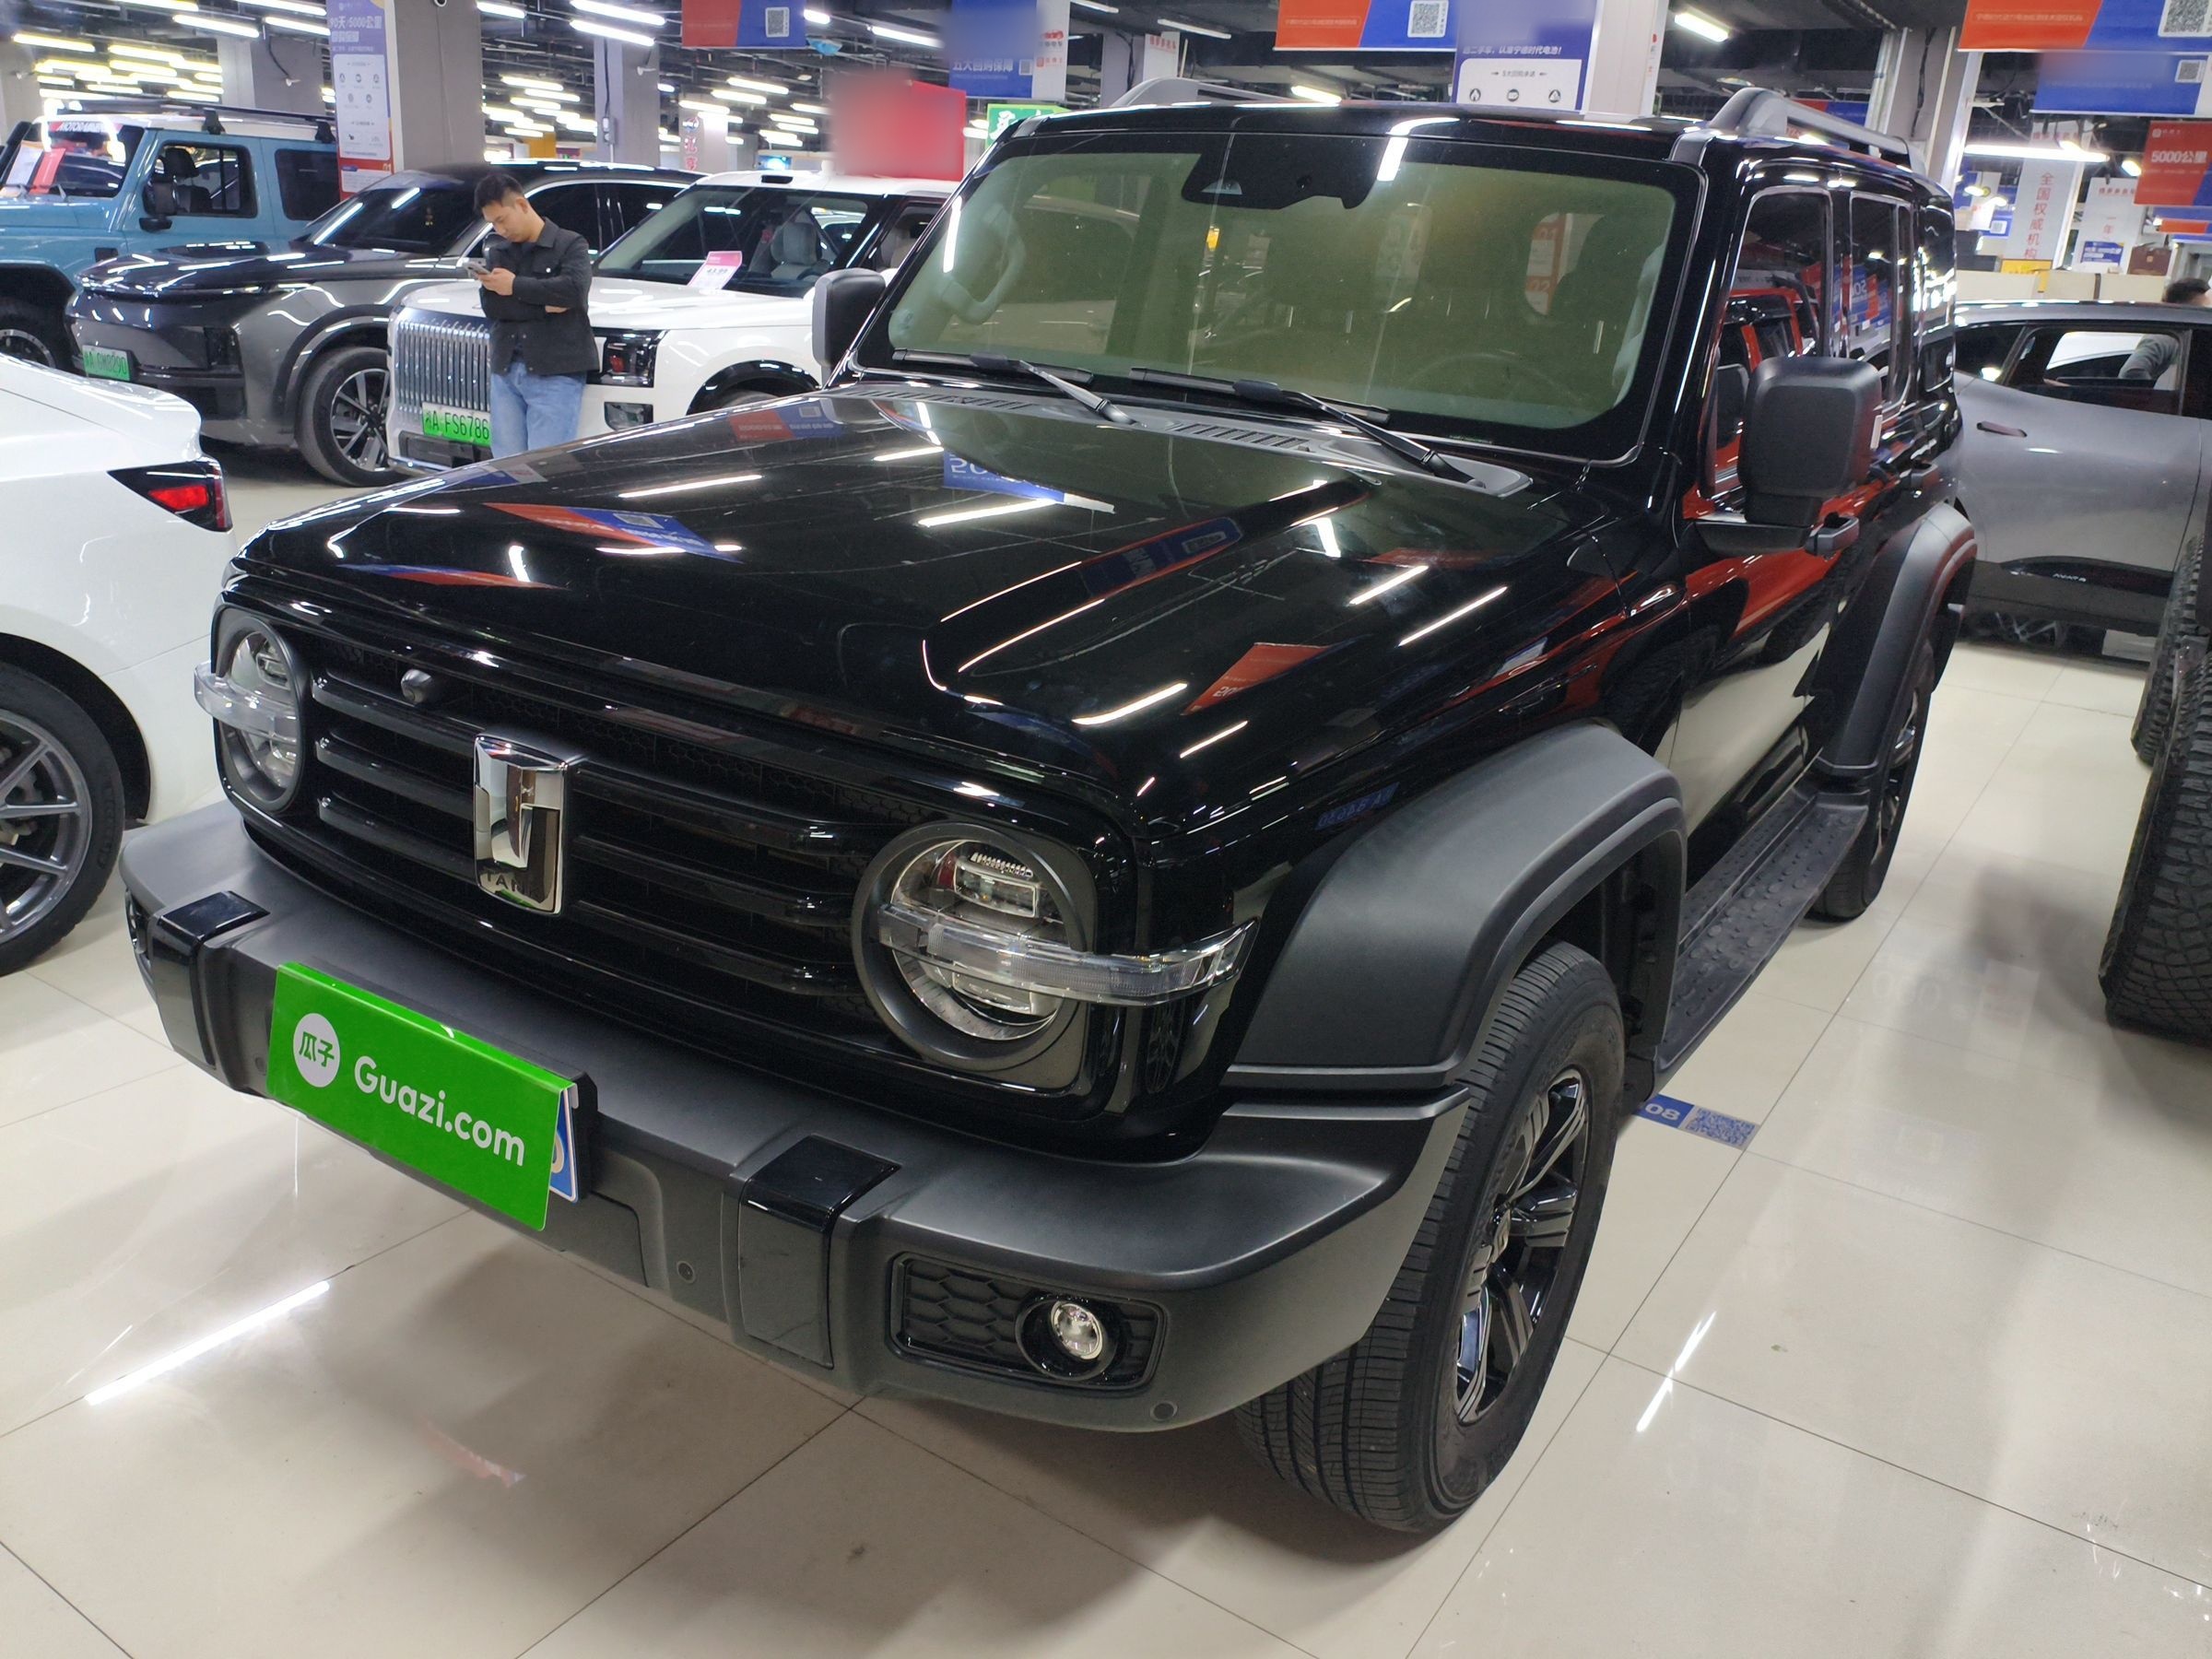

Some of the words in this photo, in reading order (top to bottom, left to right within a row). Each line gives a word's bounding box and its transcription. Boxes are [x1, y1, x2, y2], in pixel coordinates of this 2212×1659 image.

[444, 412, 490, 441] FS6786
[299, 1031, 335, 1068] 瓜子
[354, 1055, 526, 1168] Guazi.com
